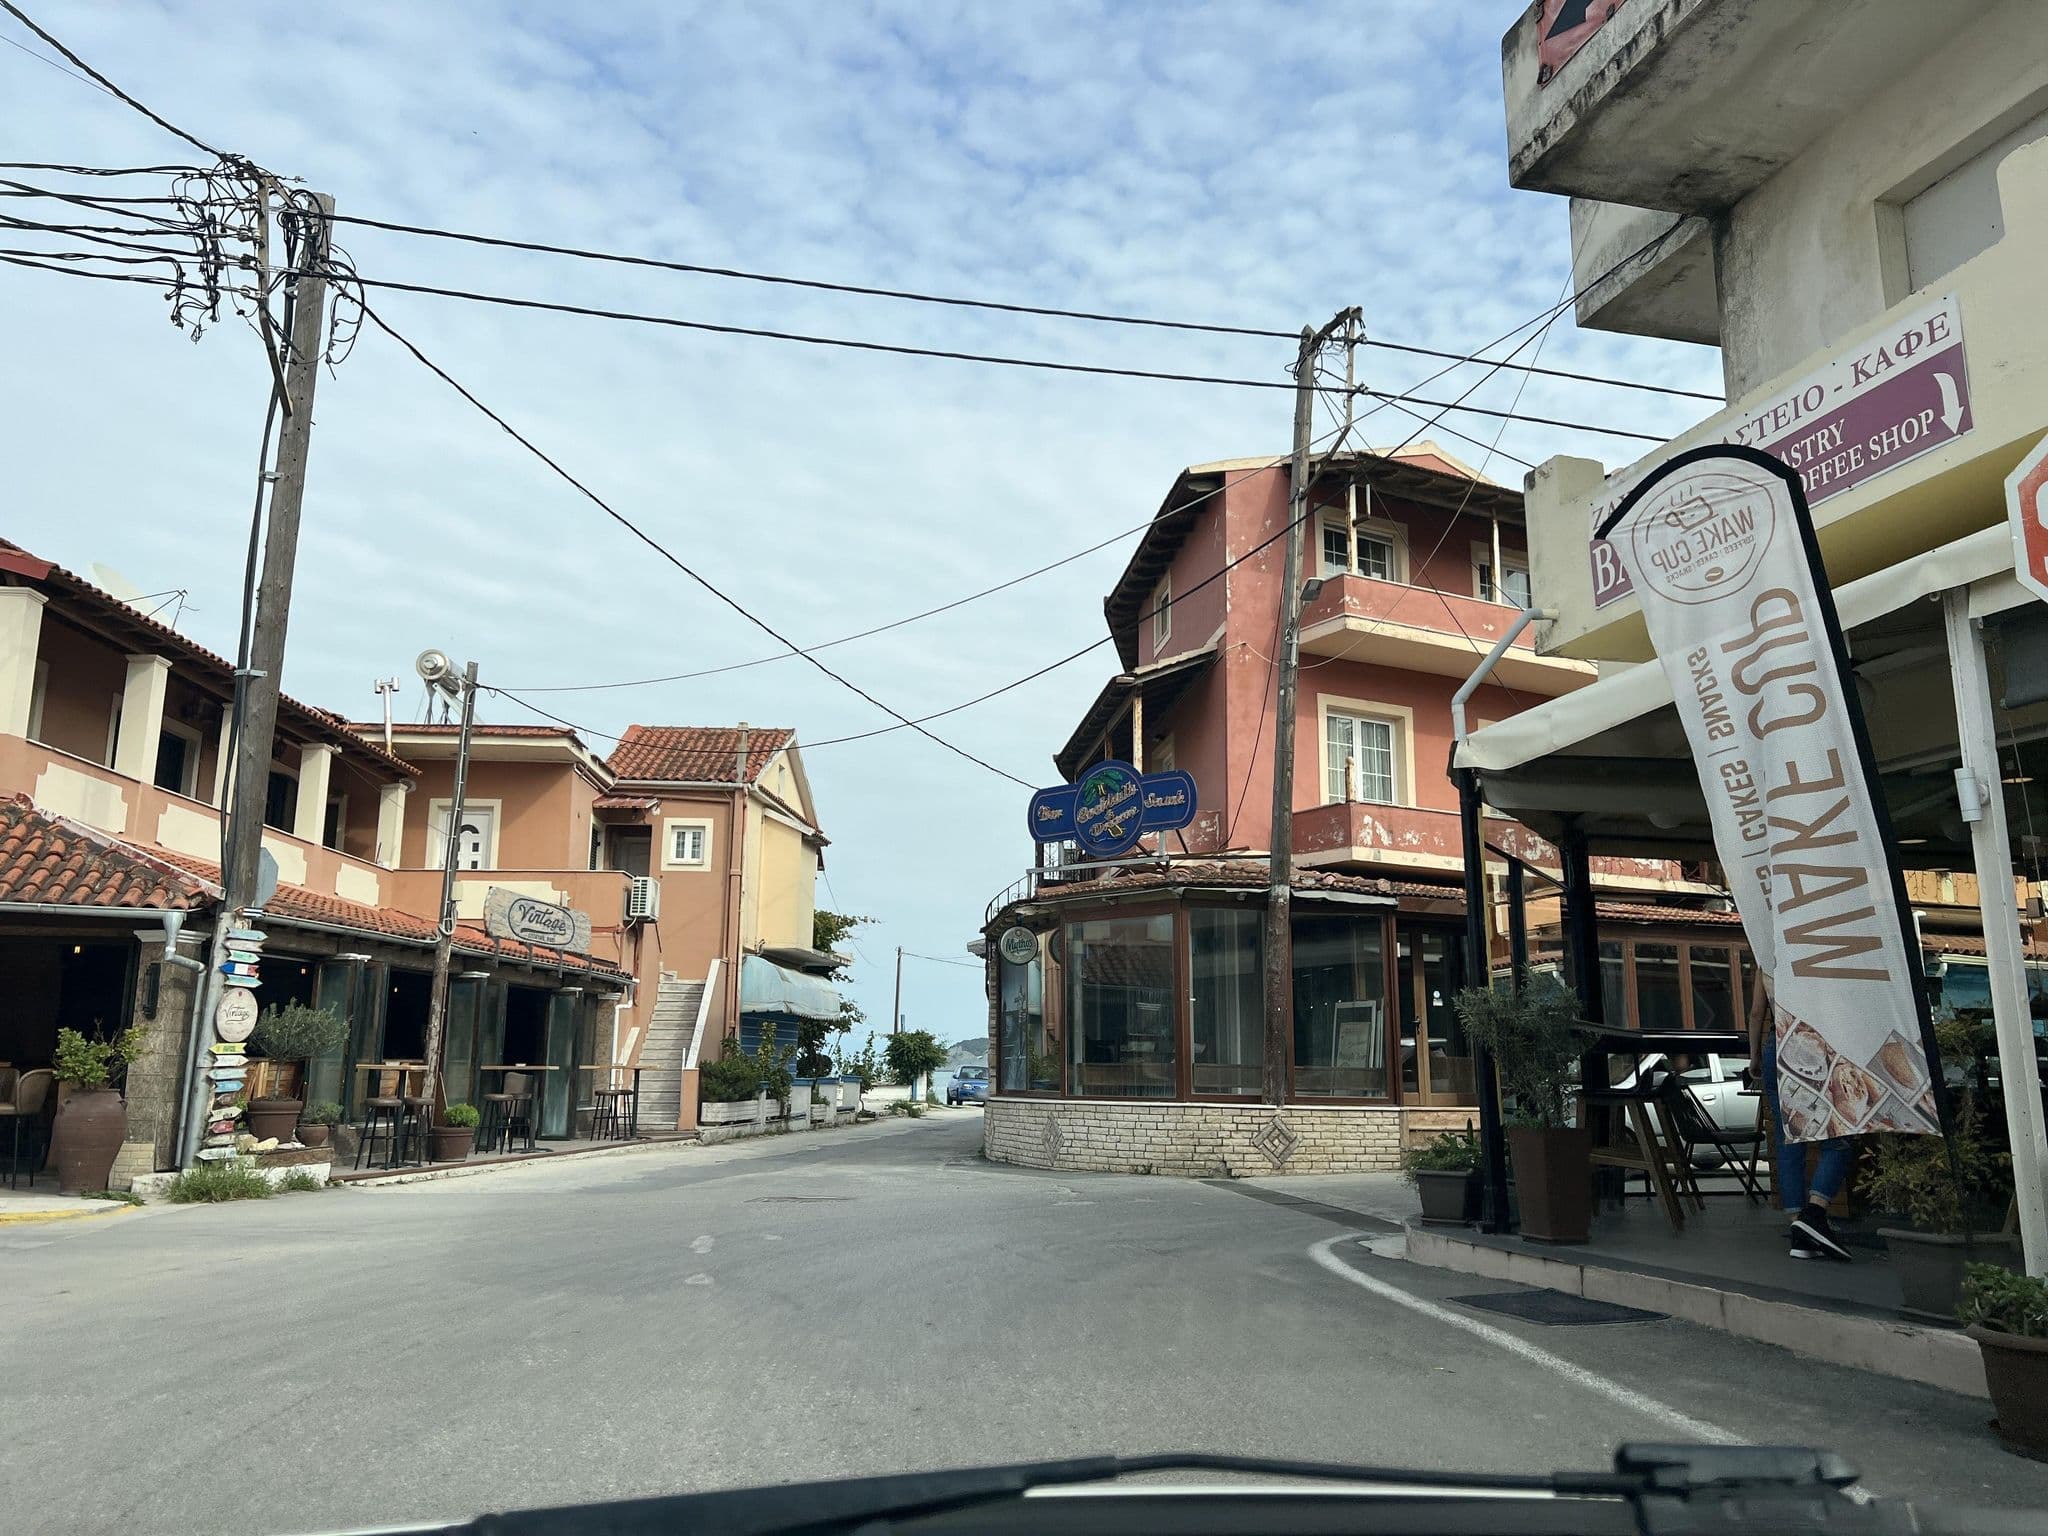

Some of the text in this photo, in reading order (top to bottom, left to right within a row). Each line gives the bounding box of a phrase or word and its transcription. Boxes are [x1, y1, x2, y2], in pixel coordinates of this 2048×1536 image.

[1850, 311, 1950, 387] ΚΑΦΕ
[1777, 418, 1846, 468] ASTRY
[1870, 408, 1935, 466] SHOP
[518, 903, 567, 933] Vintage
